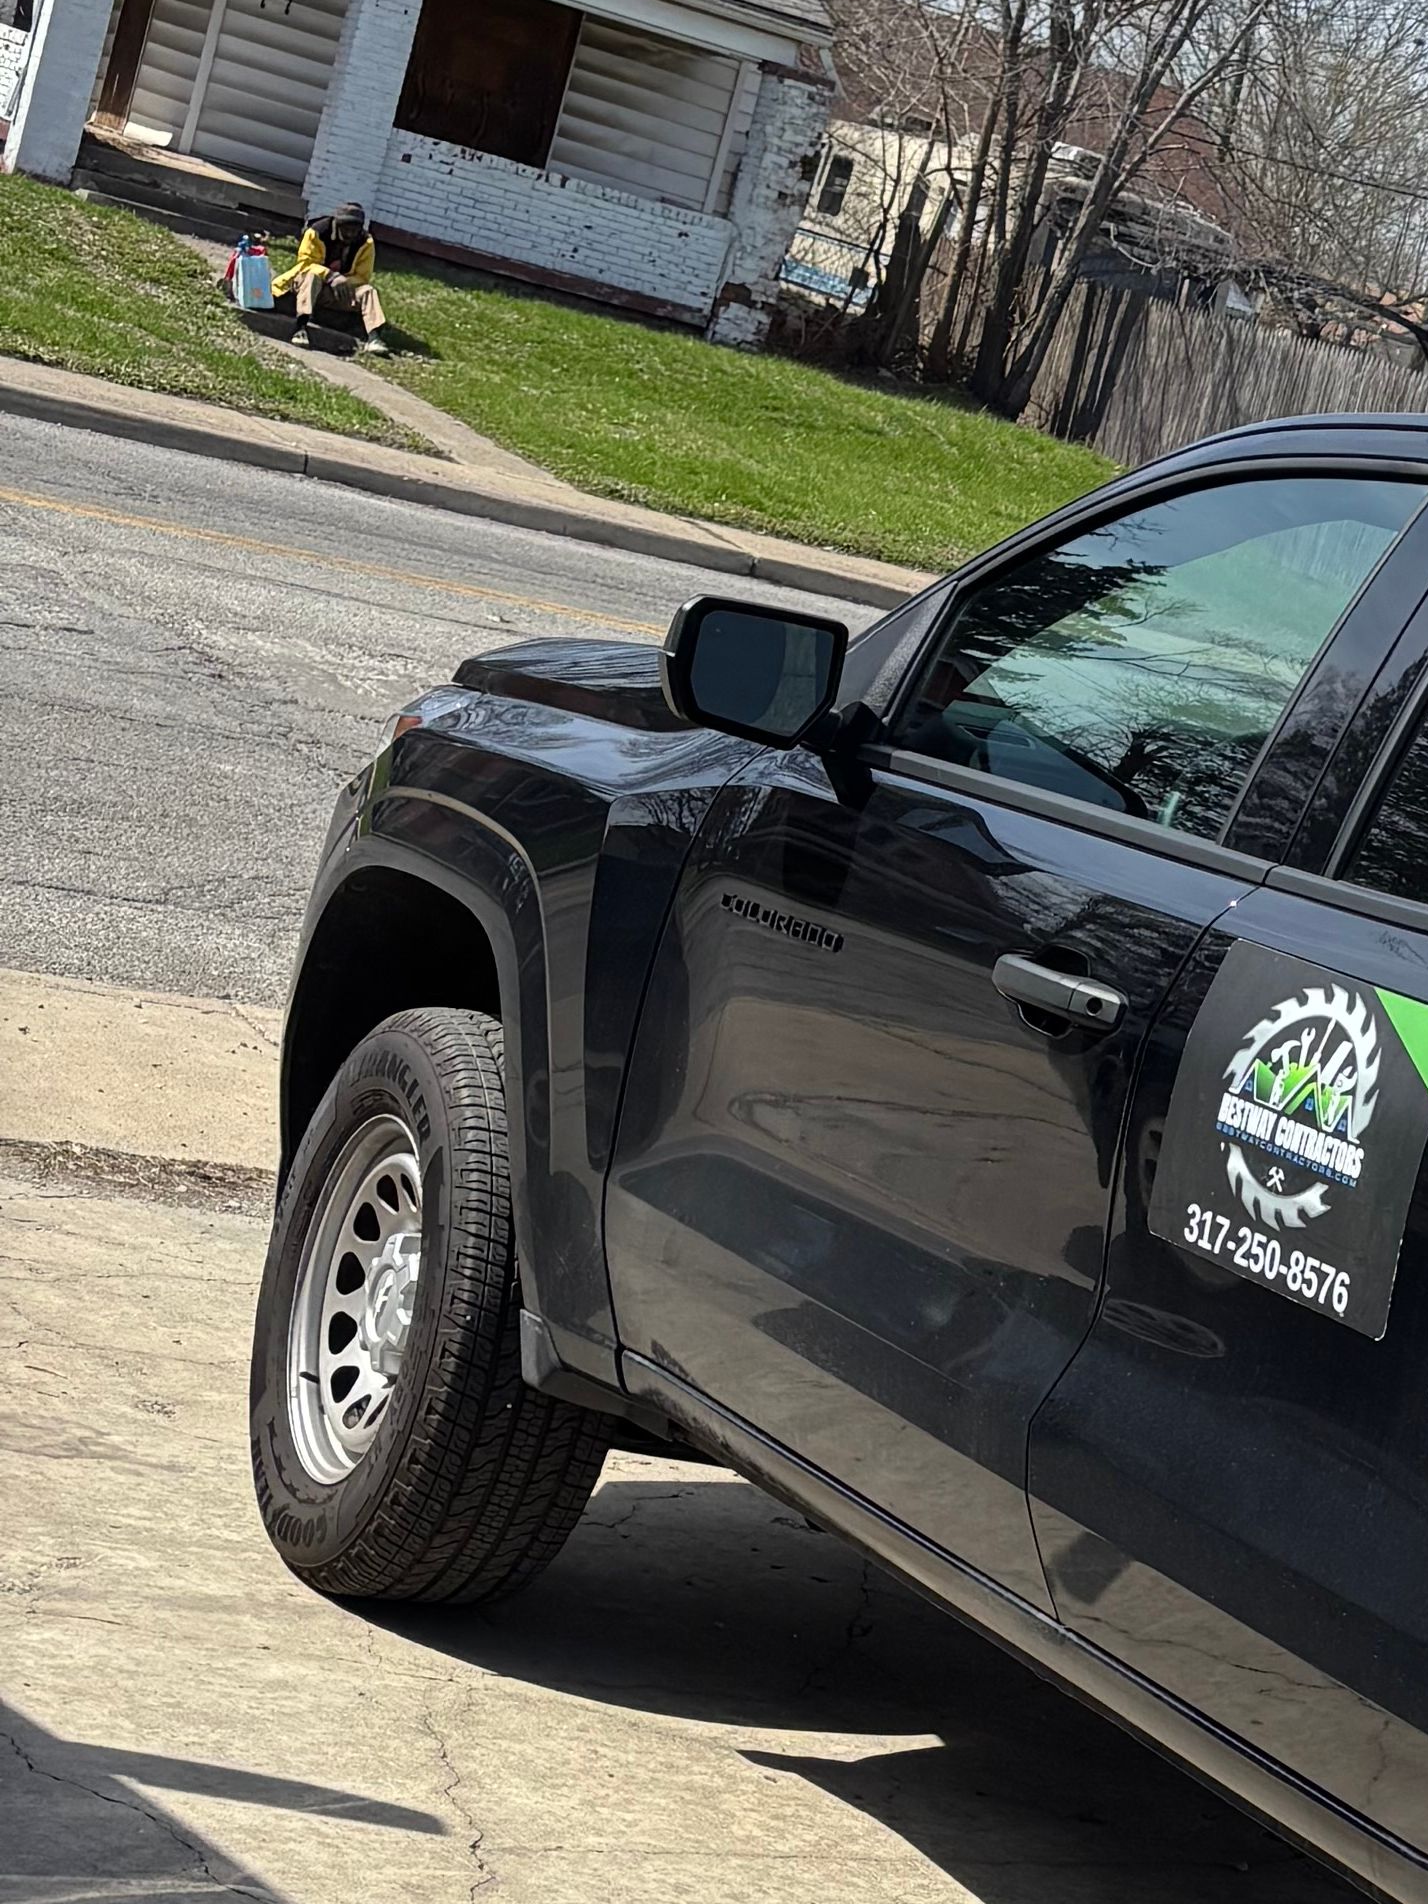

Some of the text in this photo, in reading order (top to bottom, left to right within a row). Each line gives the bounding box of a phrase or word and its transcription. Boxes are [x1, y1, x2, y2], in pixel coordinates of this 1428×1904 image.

[1217, 1092, 1365, 1179] BESTWAY CONTRACTORS
[1184, 1203, 1350, 1313] 317-250-8576
